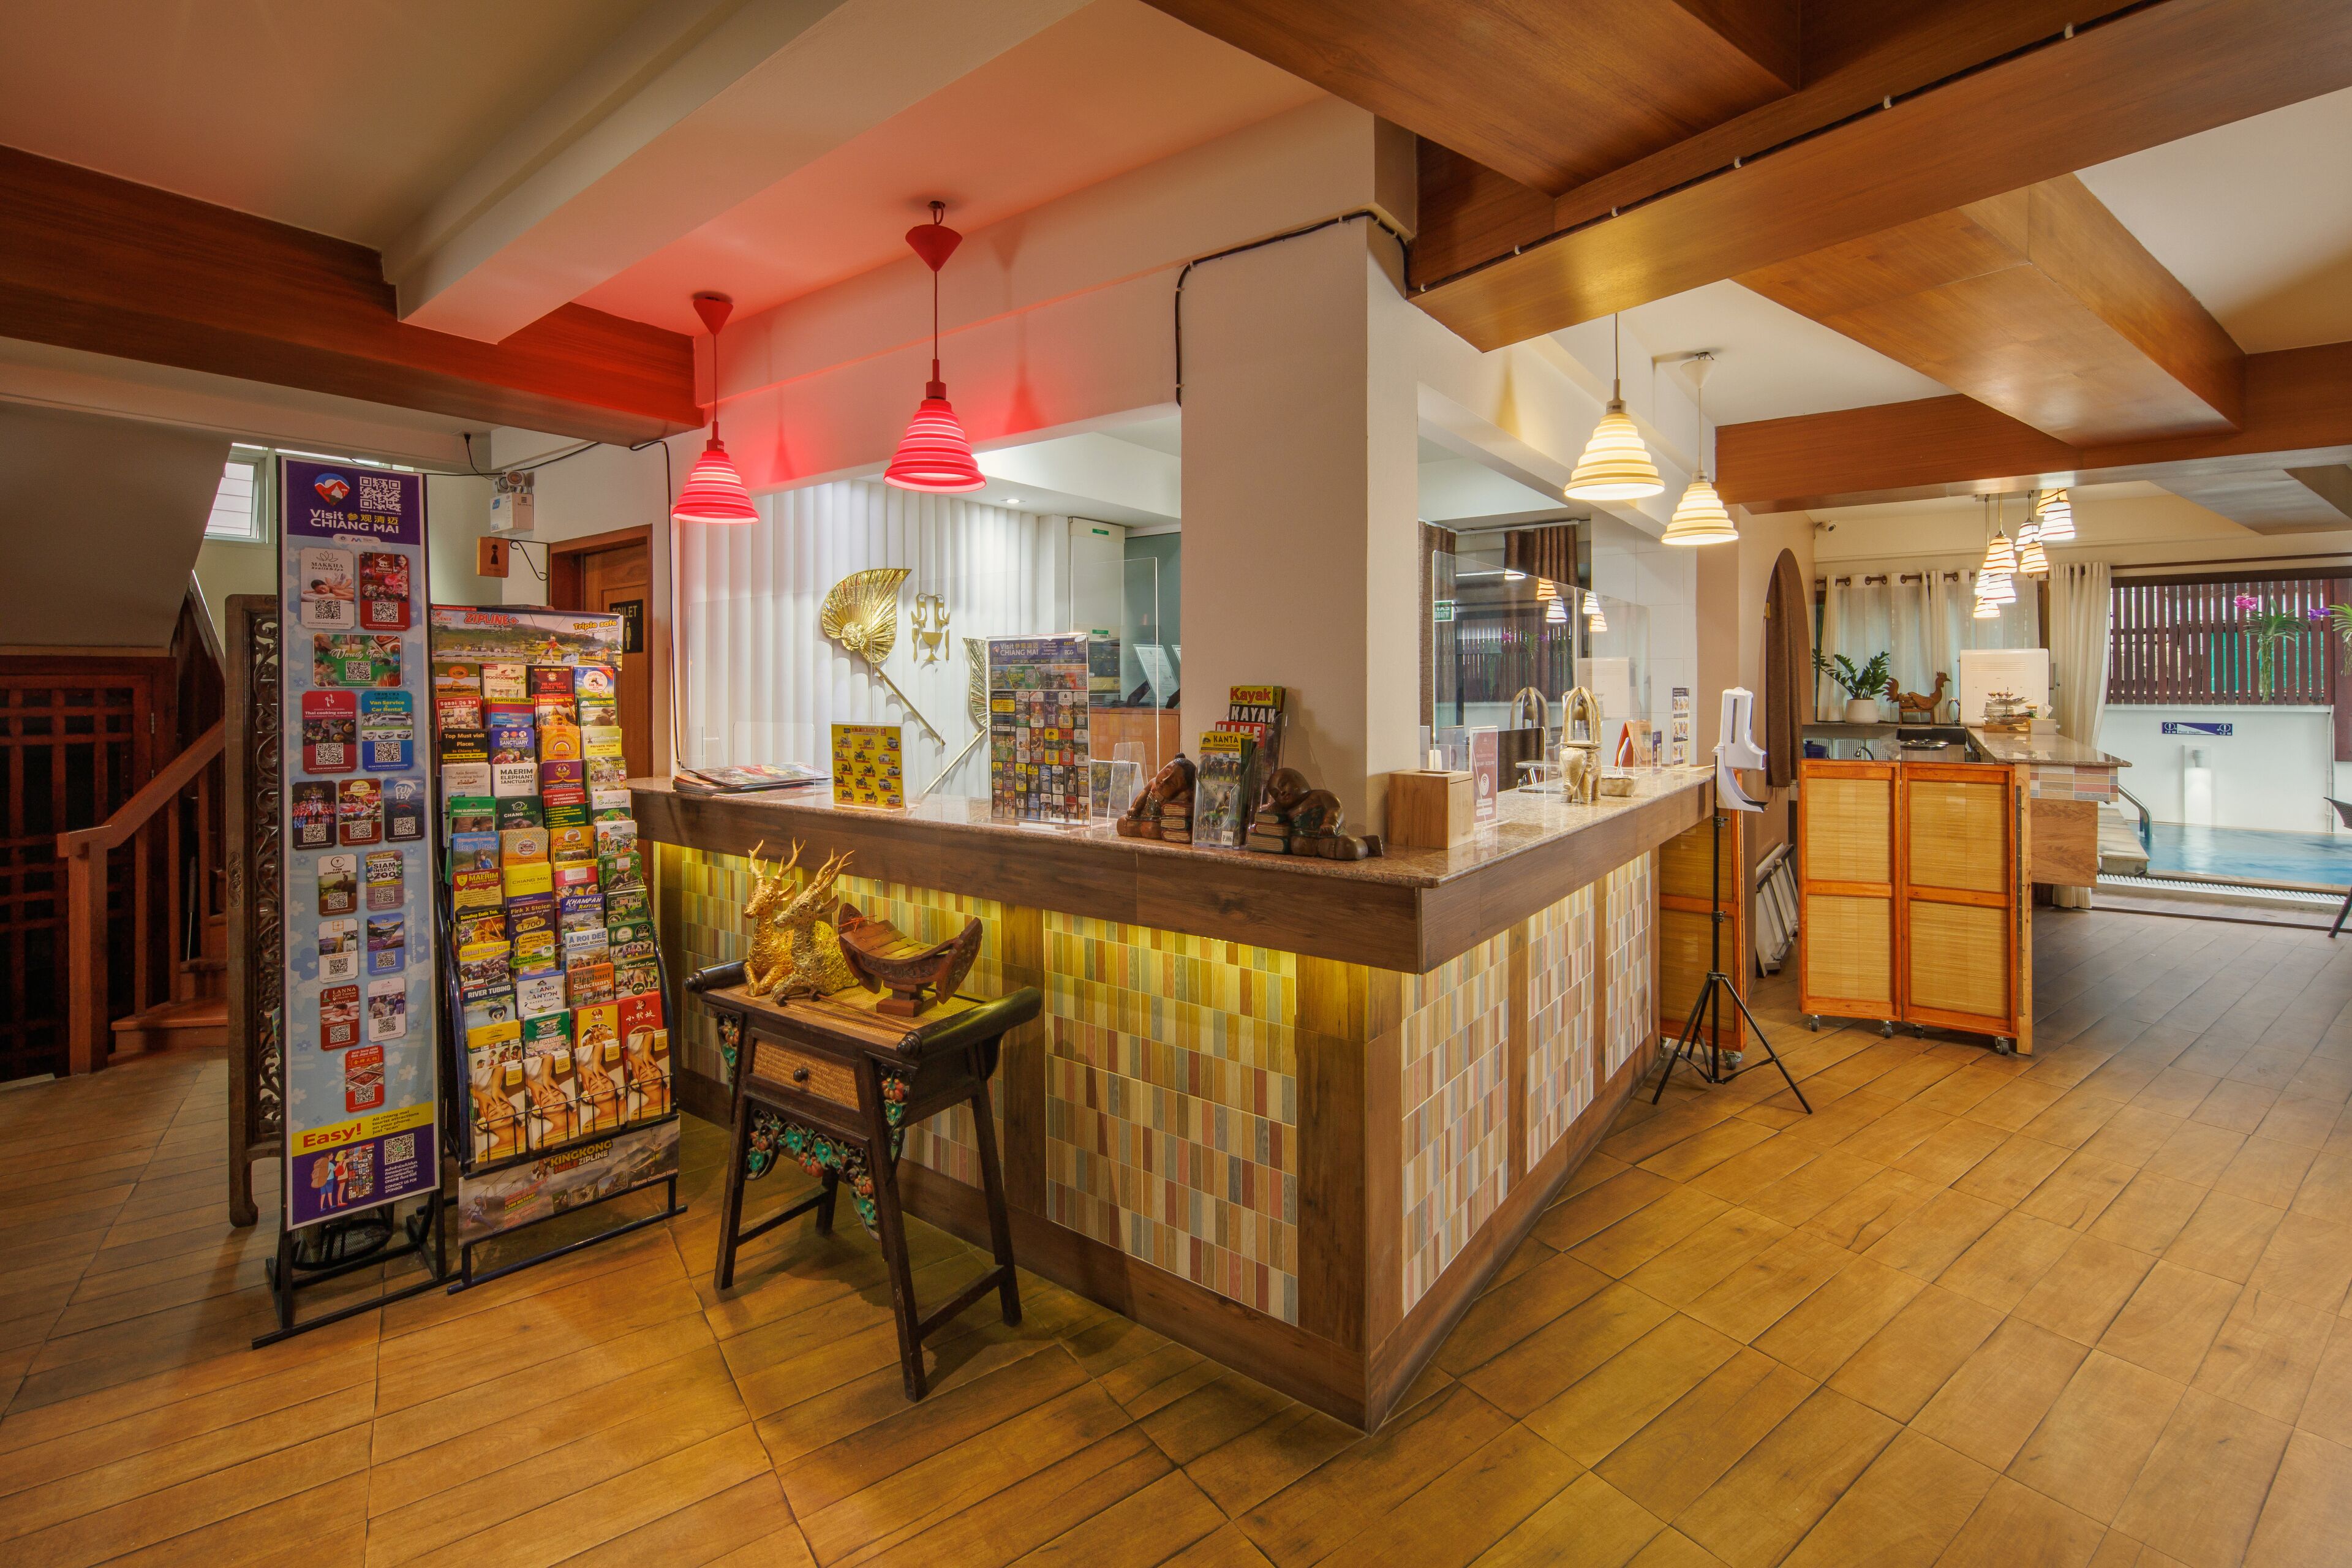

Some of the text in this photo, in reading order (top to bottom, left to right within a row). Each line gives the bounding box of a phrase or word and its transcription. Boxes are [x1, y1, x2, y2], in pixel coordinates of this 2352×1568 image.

[310, 508, 344, 520] Visit
[311, 518, 399, 534] CHIANG MAI
[573, 619, 617, 631] Triple safe
[366, 649, 385, 659] Tour
[1230, 688, 1272, 704] Kayak
[1231, 706, 1276, 723] KAYAK
[1213, 735, 1238, 744] KANTA
[598, 798, 627, 807] Galangal
[457, 840, 496, 851] Eco Trek
[374, 871, 396, 880] ZOO
[469, 872, 499, 881] MAERIM
[566, 897, 602, 907] KHAMPAN
[521, 920, 541, 930] 1,700
[592, 931, 606, 940] DEE
[585, 967, 611, 975] Inthanon
[573, 972, 611, 984] Elephant
[529, 986, 554, 994] GRAND
[573, 980, 611, 990] Sanctuary
[467, 984, 511, 998] RIVER TUBING
[526, 991, 557, 1000] CANYON
[391, 1112, 420, 1121] attractions
[303, 1122, 361, 1148] Easy!
[550, 1139, 612, 1167] KINGKONG
[553, 1150, 609, 1174] SMILE ZIPLINE
[631, 1178, 647, 1187] Please
[647, 1173, 666, 1183] Contact
